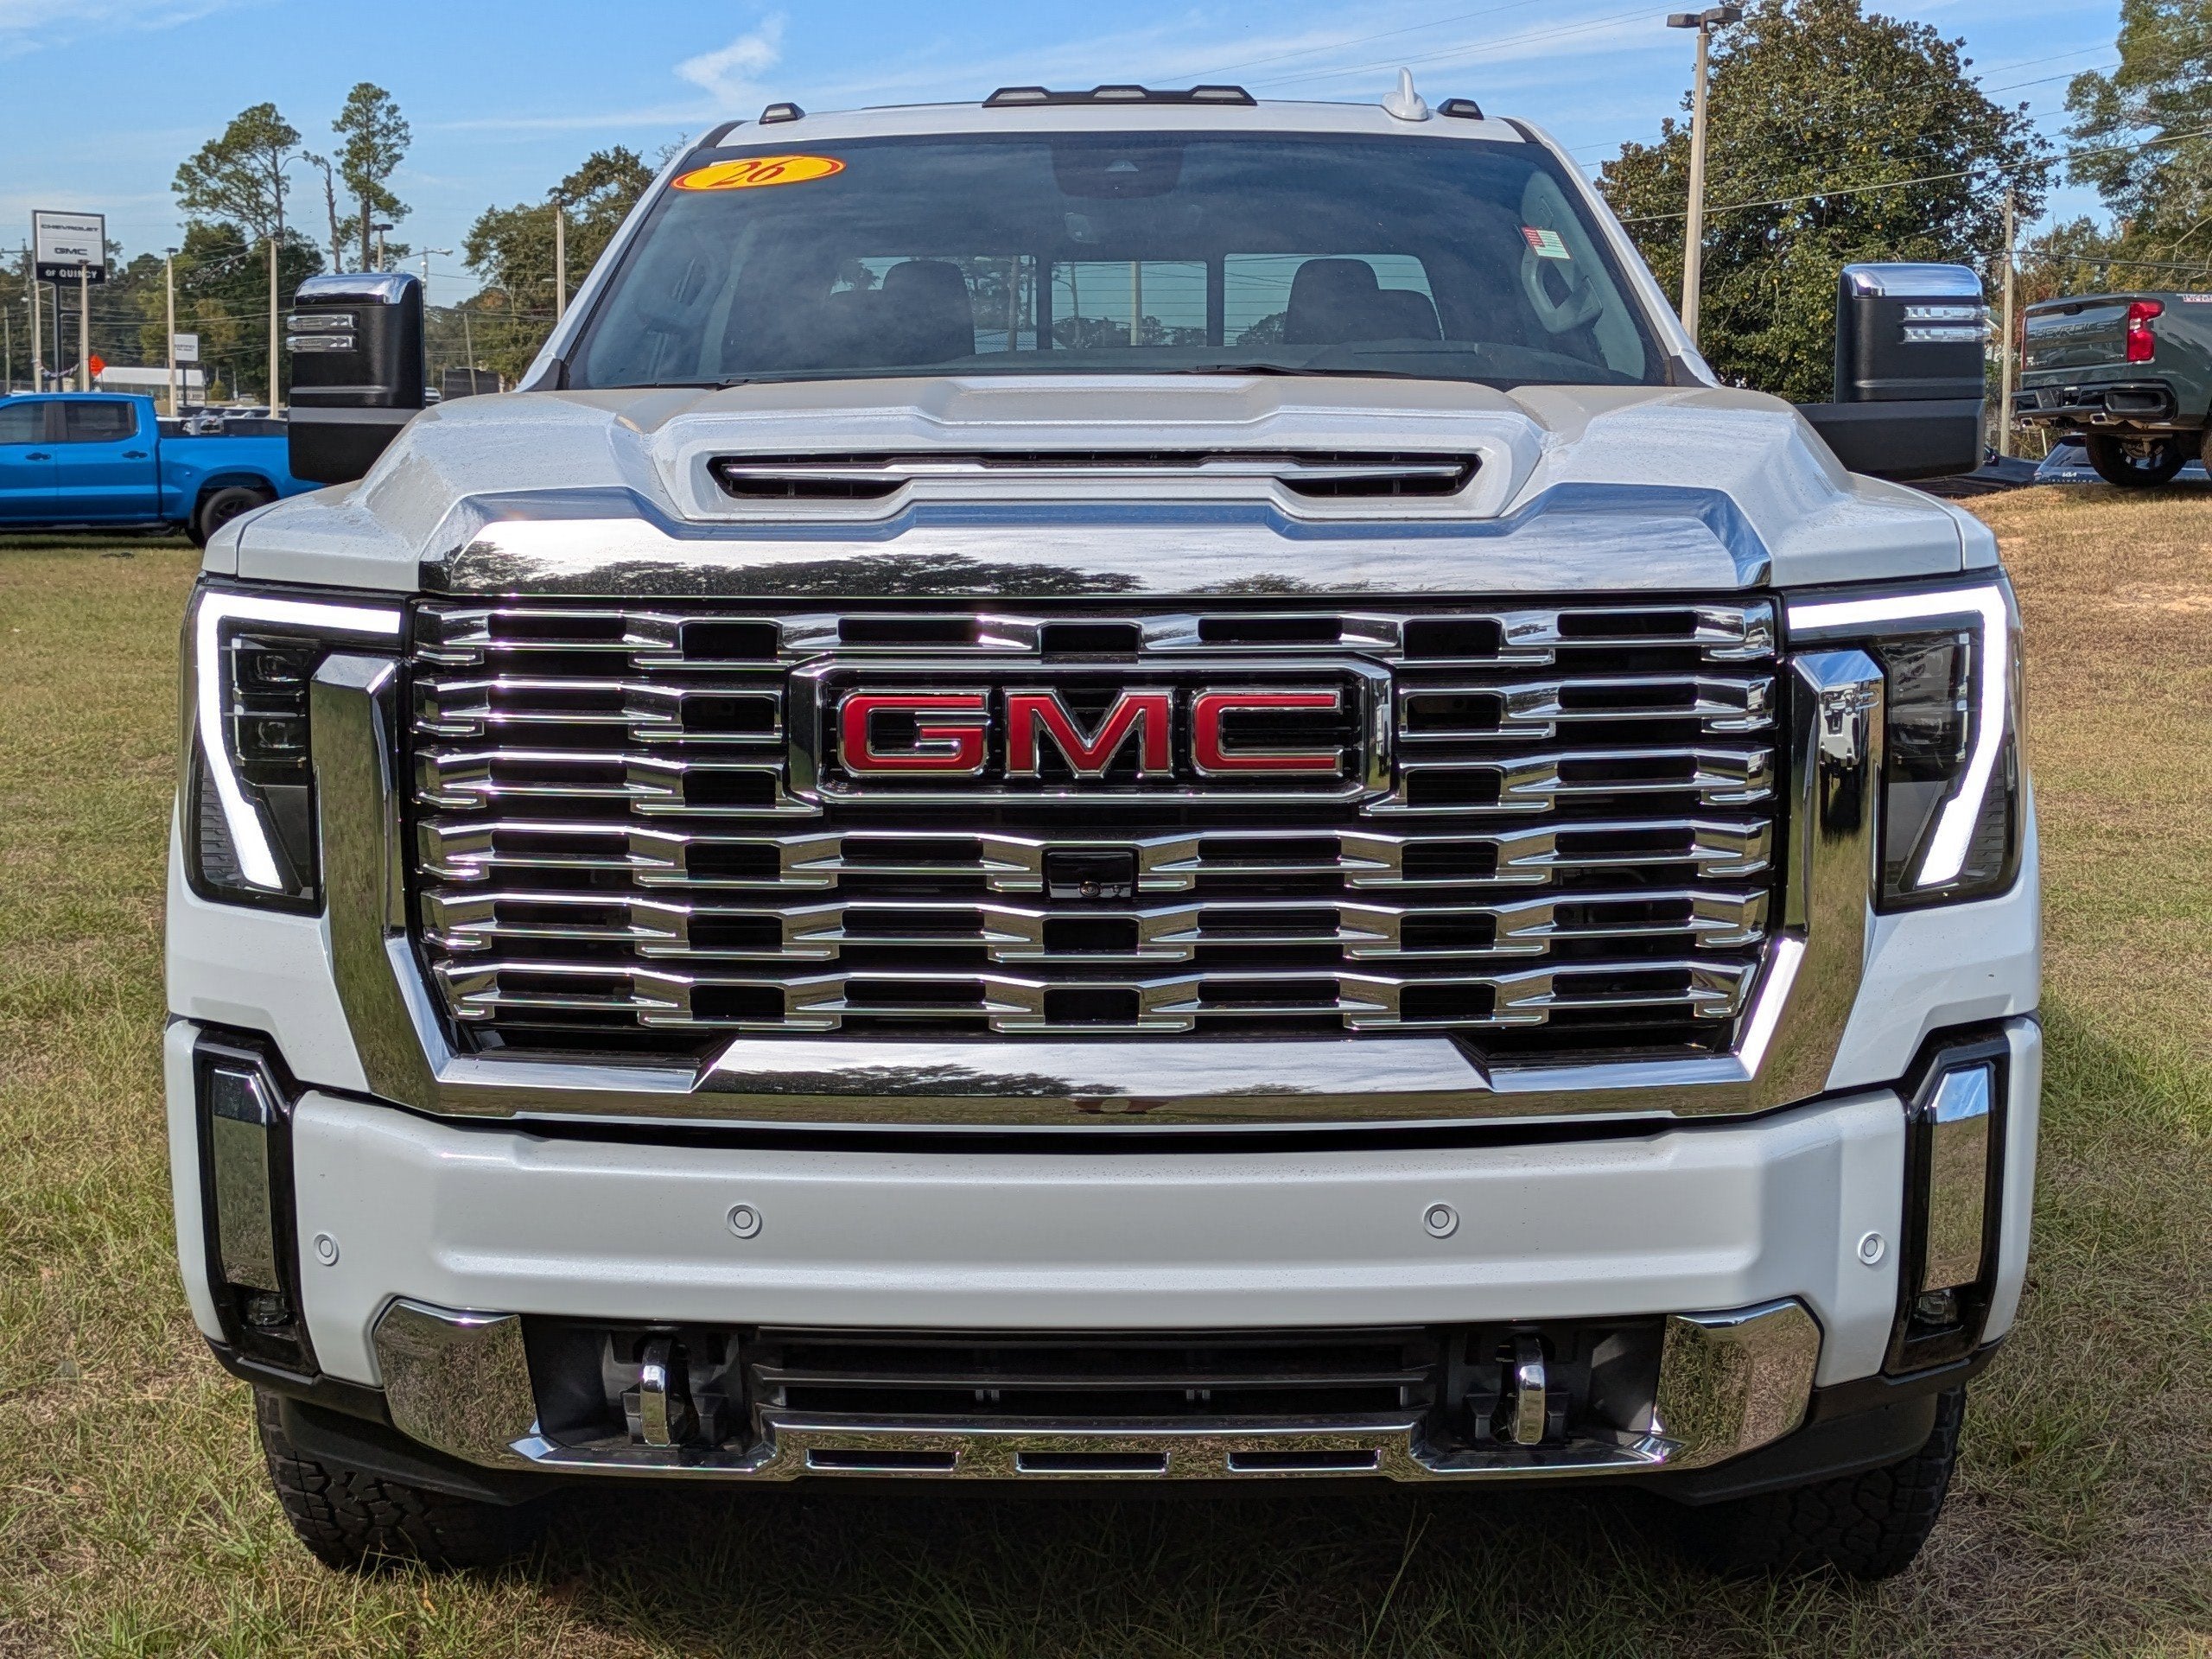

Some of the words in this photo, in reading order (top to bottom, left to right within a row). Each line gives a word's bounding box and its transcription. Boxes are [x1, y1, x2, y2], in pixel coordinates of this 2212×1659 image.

[706, 157, 804, 188] 26
[41, 224, 99, 232] CHEVROLET
[54, 247, 88, 256] GMC
[836, 686, 1344, 779] GMC
